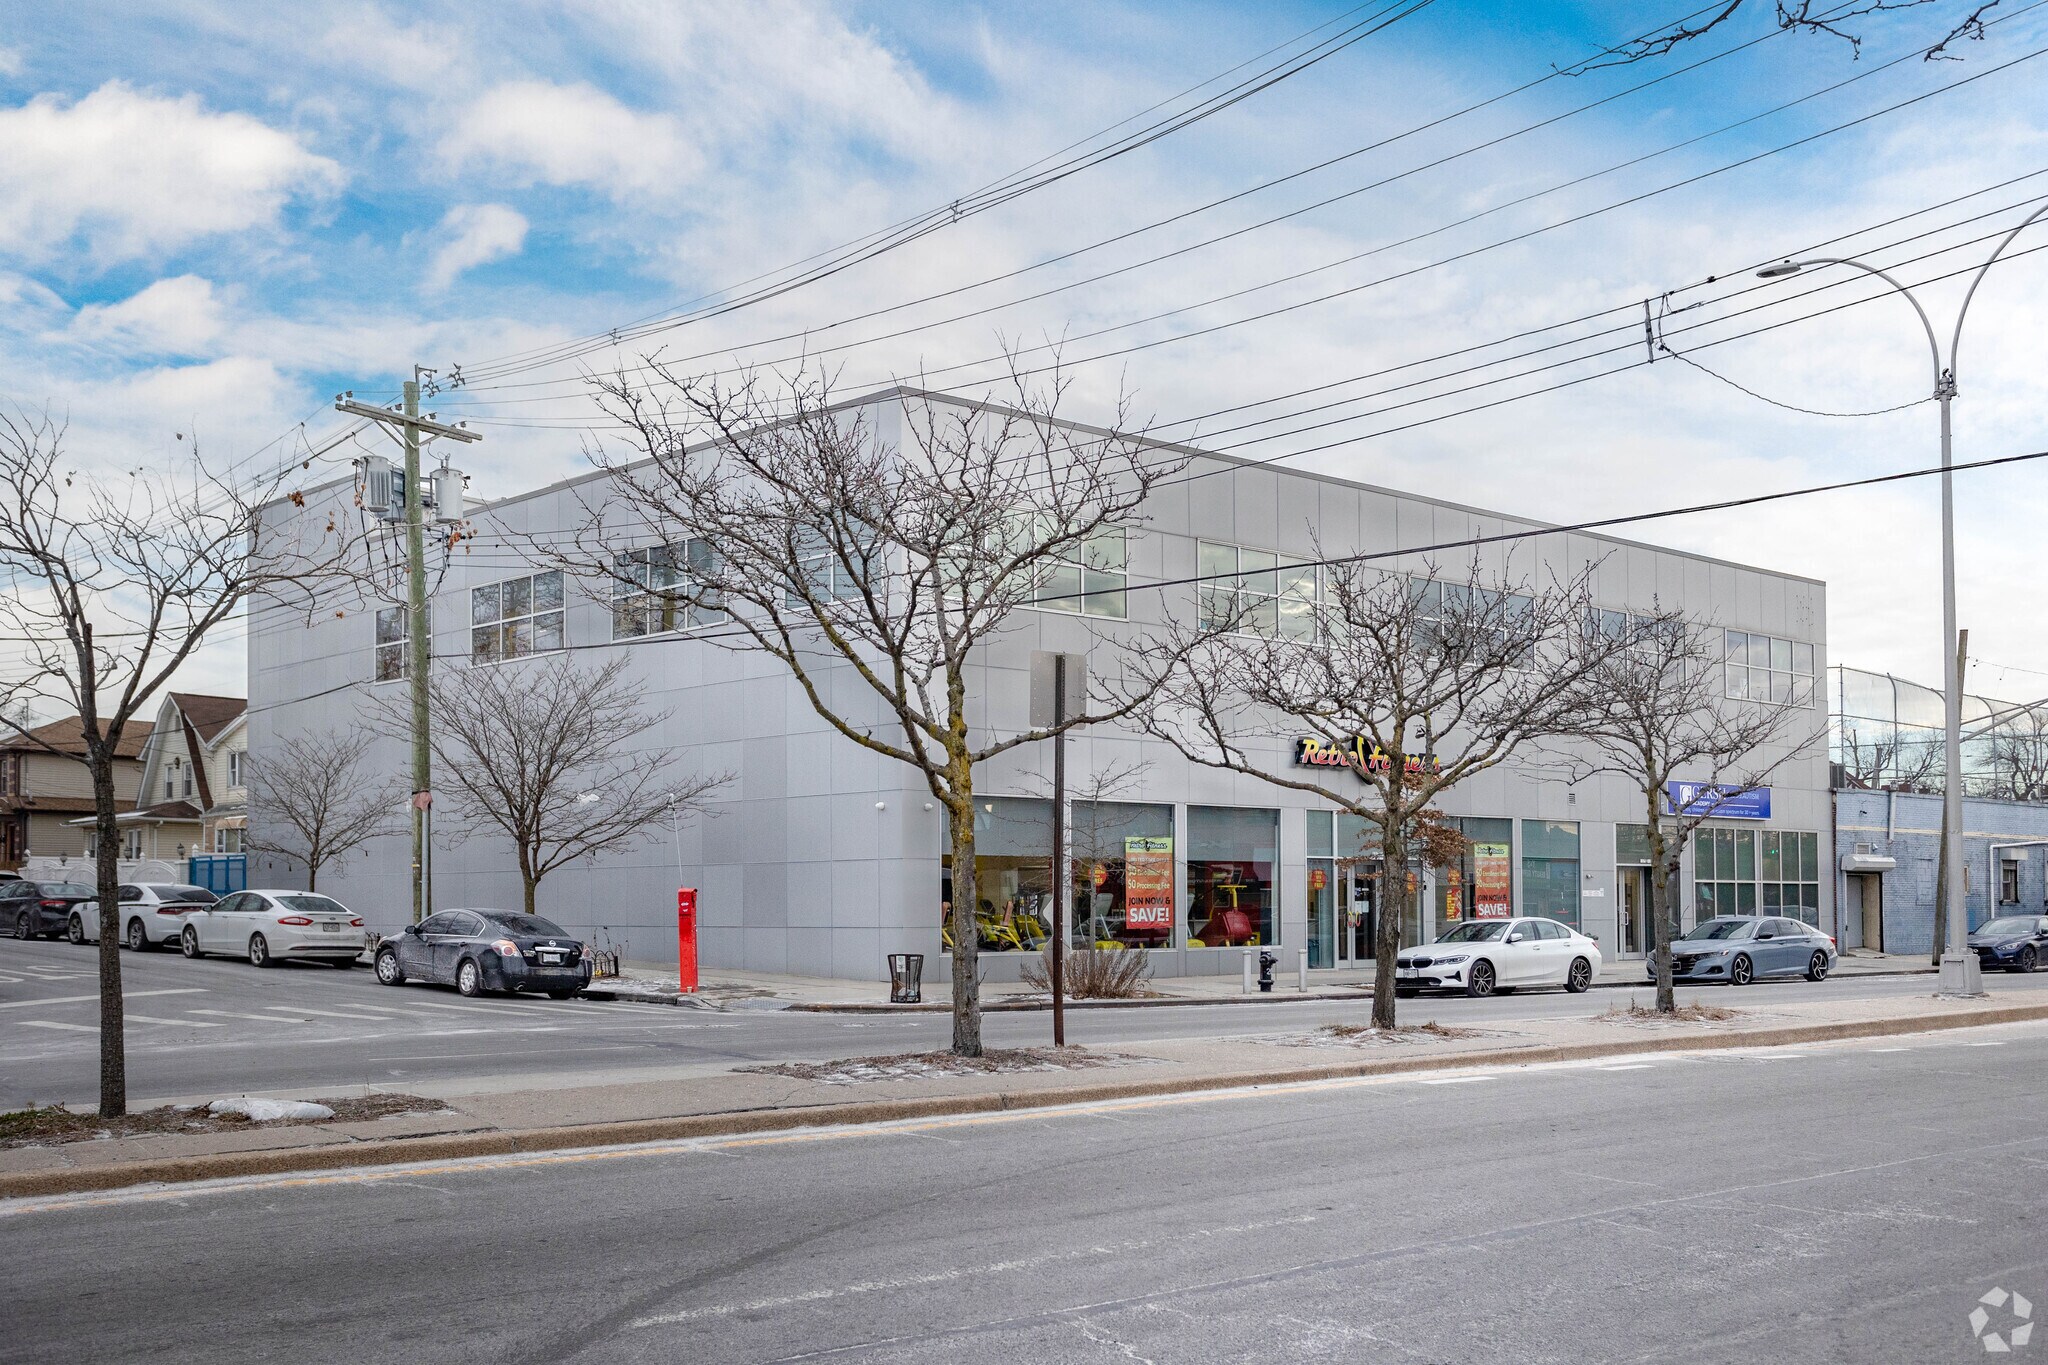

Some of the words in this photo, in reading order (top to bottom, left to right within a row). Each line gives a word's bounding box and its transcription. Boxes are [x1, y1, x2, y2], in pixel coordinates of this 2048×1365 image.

[1128, 896, 1144, 906] JOIN
[1145, 896, 1163, 904] NOW
[1129, 907, 1170, 922] SAVE!
[1478, 903, 1507, 916] SAVE!
